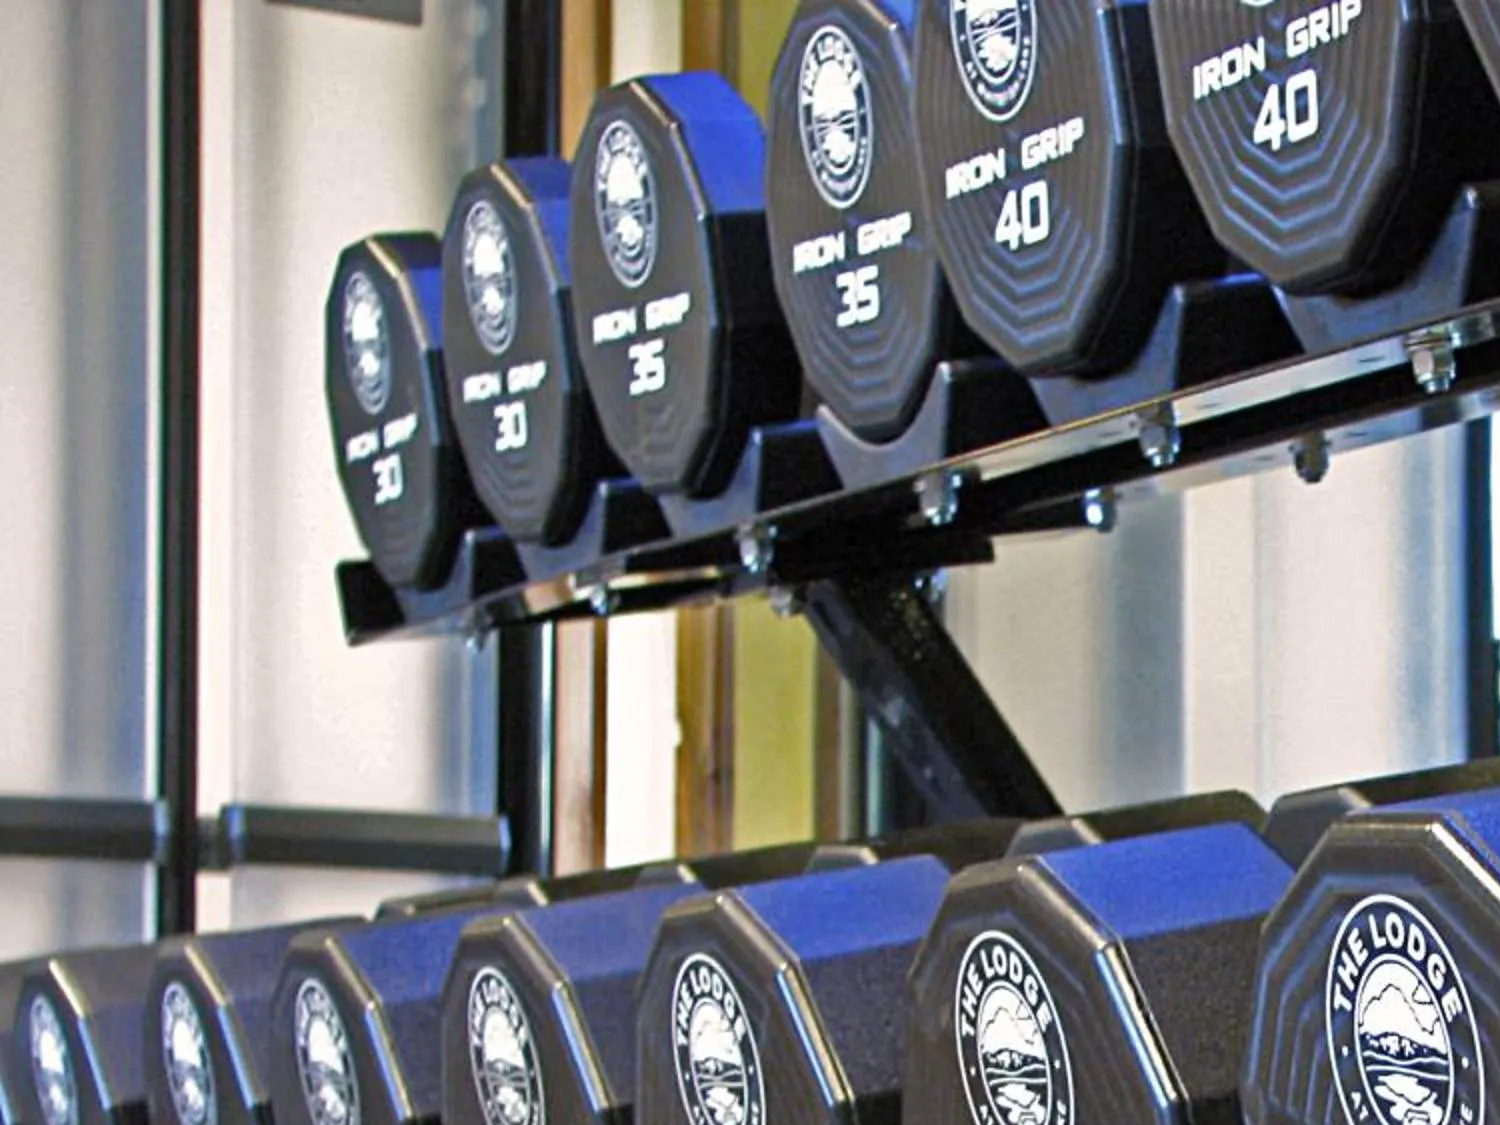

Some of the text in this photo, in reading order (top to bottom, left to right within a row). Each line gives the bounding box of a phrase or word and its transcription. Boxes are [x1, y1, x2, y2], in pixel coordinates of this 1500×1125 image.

[1193, 0, 1362, 100] IRON GRIP
[1253, 69, 1319, 151] 40
[945, 117, 1084, 199] IRON GRIP
[793, 211, 911, 273] IRON GRIP
[995, 180, 1049, 250] 40
[836, 265, 880, 327] 35
[628, 338, 665, 395] 35
[493, 401, 527, 451] 30
[372, 453, 403, 504] 30
[961, 945, 1052, 1036] THE LODGE
[1333, 912, 1463, 1023] THE LODGE
